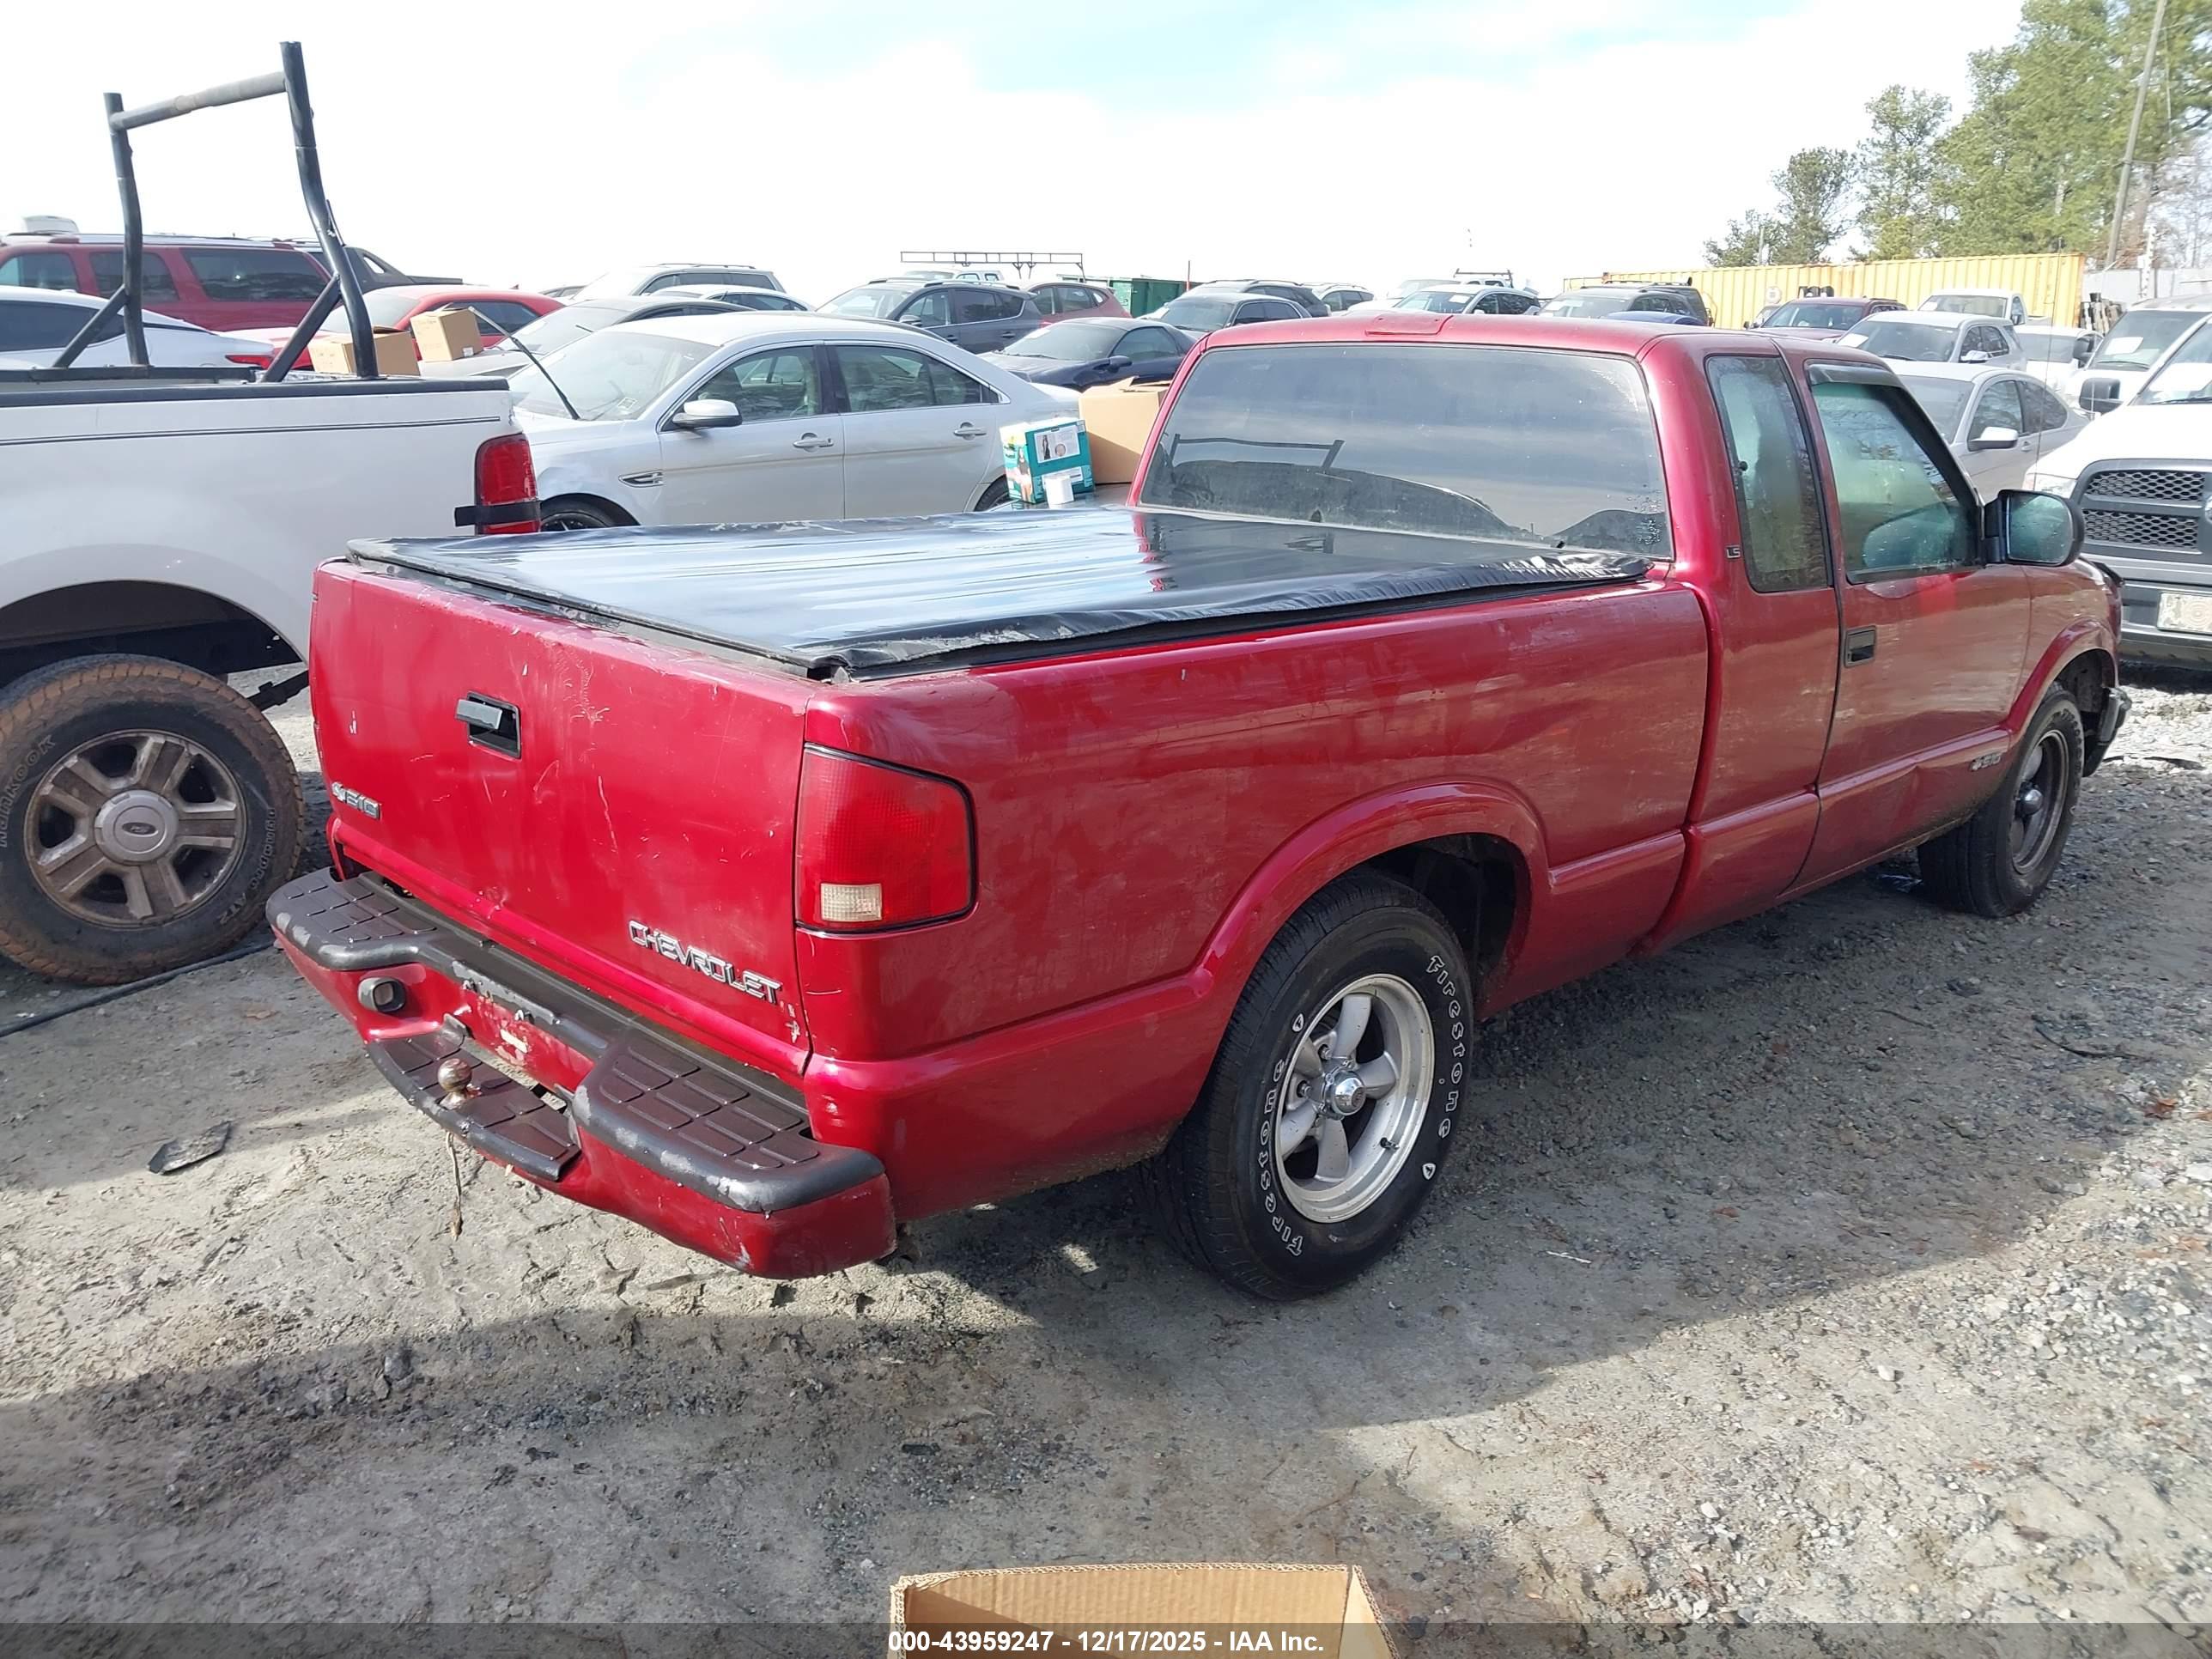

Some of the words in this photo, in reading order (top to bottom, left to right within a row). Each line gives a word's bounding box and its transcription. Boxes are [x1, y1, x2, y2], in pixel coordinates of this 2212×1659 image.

[1726, 547, 1741, 558] LS
[629, 919, 782, 1004] CHEVROLET
[1425, 954, 1466, 1139] Firestone
[1258, 1059, 1304, 1256] Firestone
